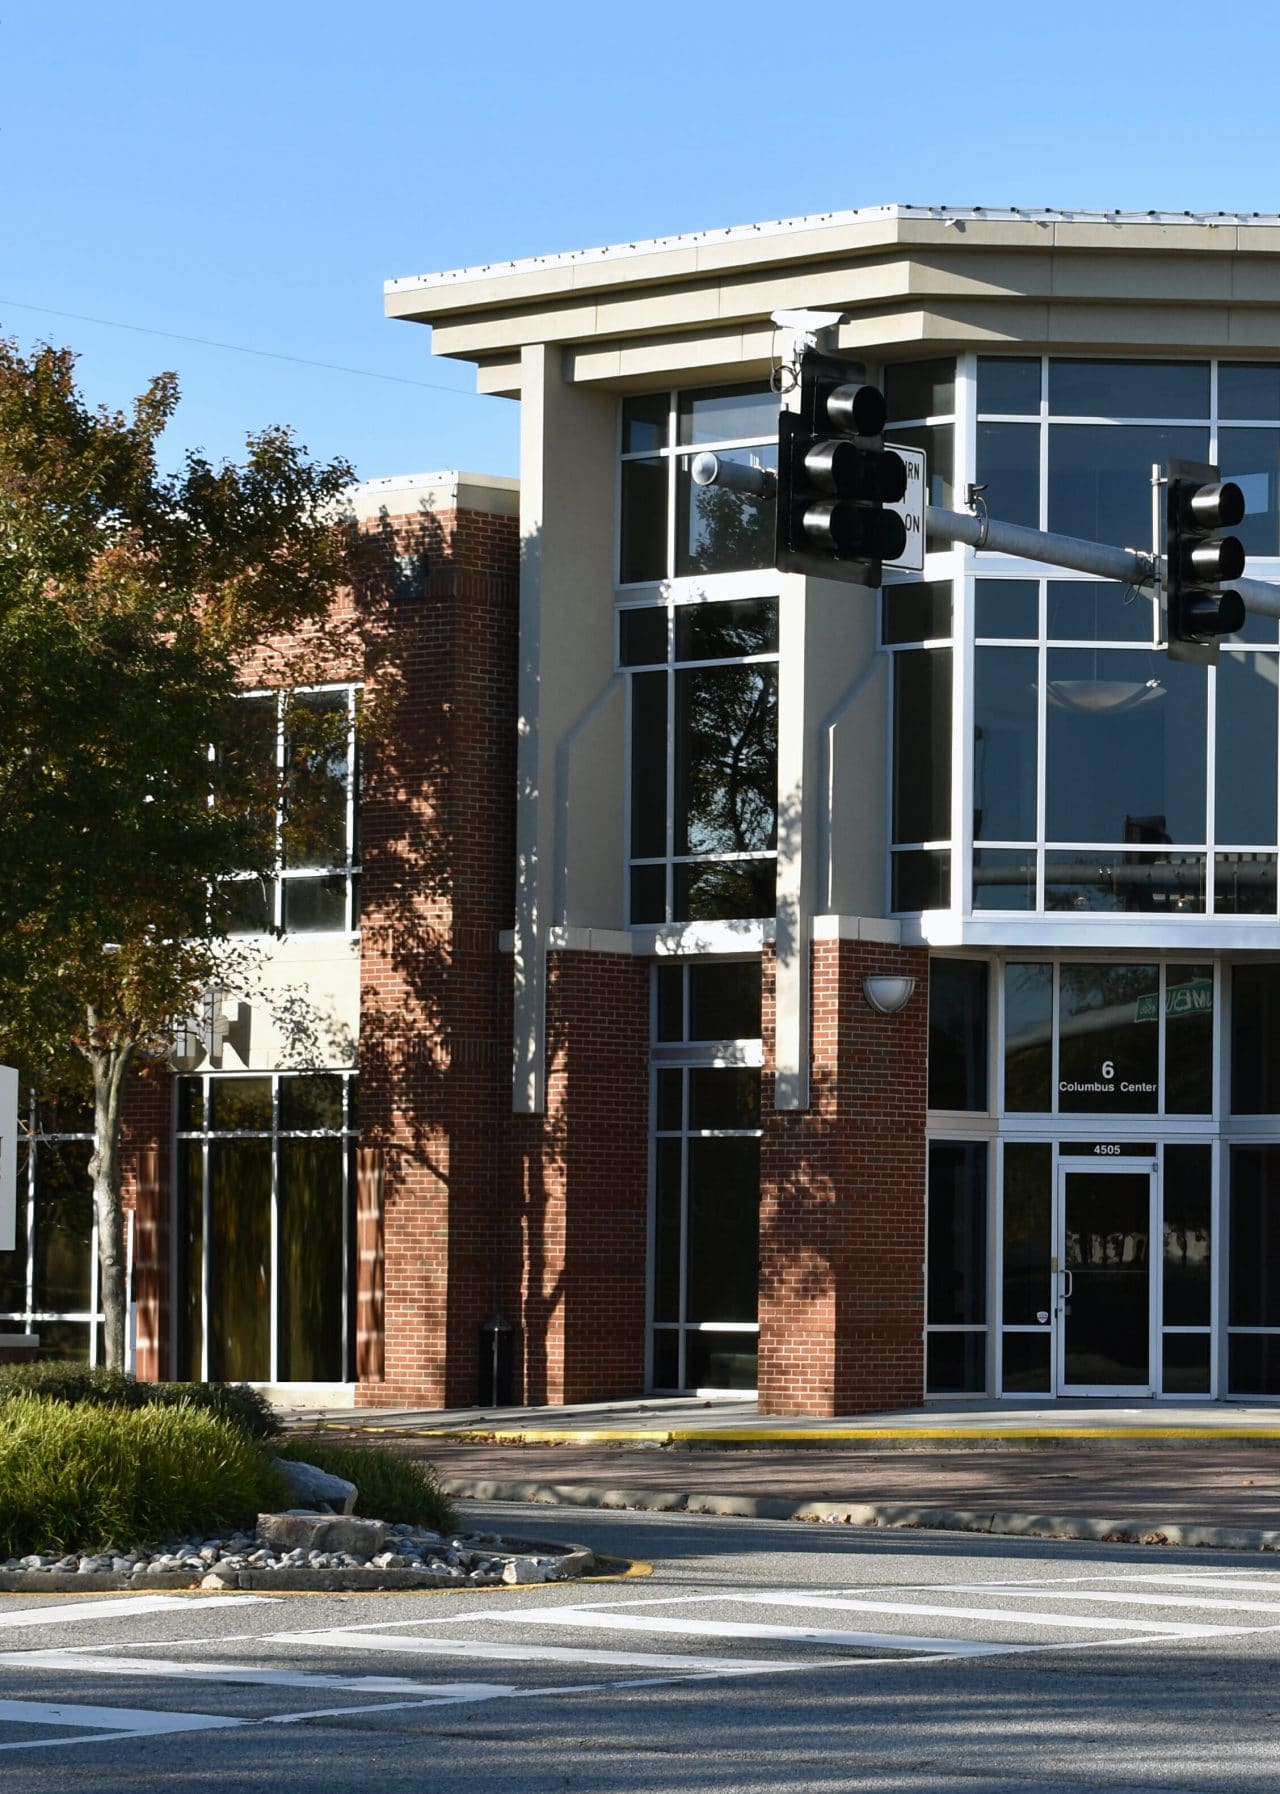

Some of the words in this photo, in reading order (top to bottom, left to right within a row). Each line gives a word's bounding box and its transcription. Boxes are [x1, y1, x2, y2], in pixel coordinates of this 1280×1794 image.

[1102, 1061, 1115, 1079] 6
[1059, 1081, 1115, 1092] Columbus
[1120, 1081, 1157, 1092] Center
[1094, 1145, 1121, 1155] 4505
